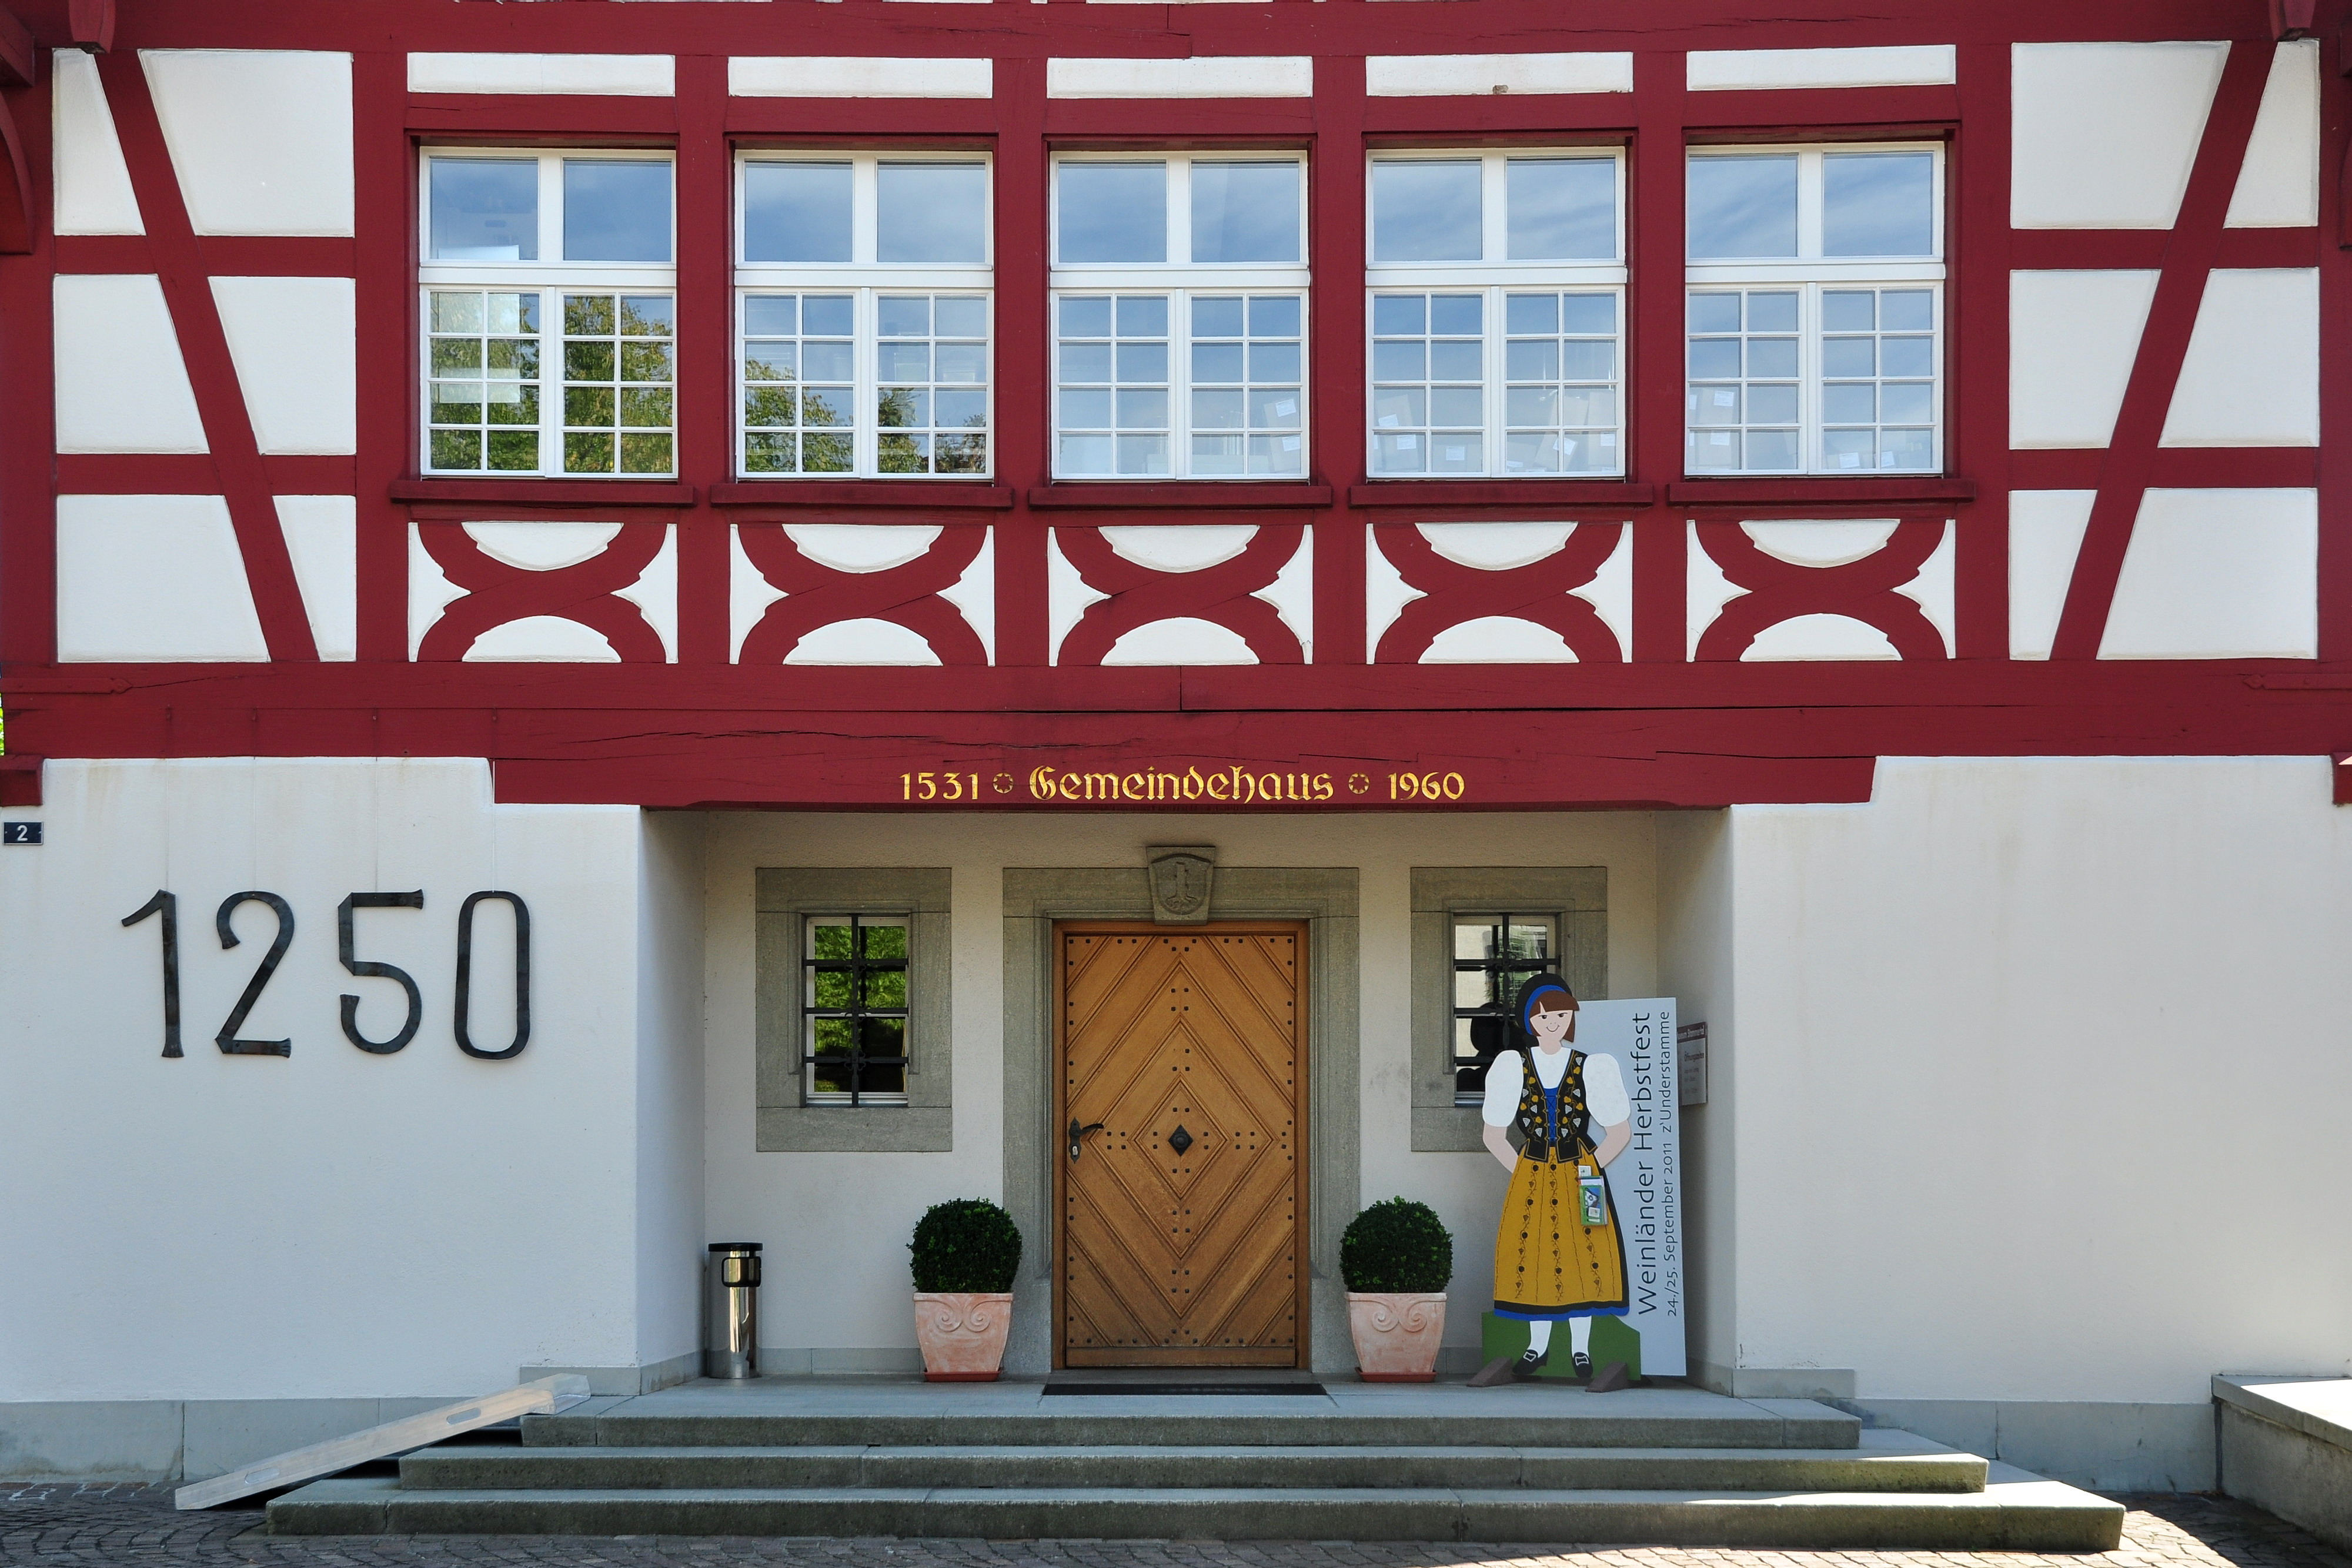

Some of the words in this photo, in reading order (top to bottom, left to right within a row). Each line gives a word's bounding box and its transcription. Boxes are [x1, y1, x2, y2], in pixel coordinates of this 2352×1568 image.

[899, 771, 978, 800] 1531
[1029, 765, 1335, 804] Gemeindehaus
[1387, 771, 1465, 800] 1960
[17, 824, 28, 841] 2
[121, 889, 532, 1059] 1250
[1630, 1012, 1653, 1151] Herbstfest
[1662, 1143, 1673, 1175] 2011
[1633, 1160, 1657, 1315] Weinländer
[1661, 1179, 1678, 1262] September
[1664, 1266, 1679, 1317] 24./25.
